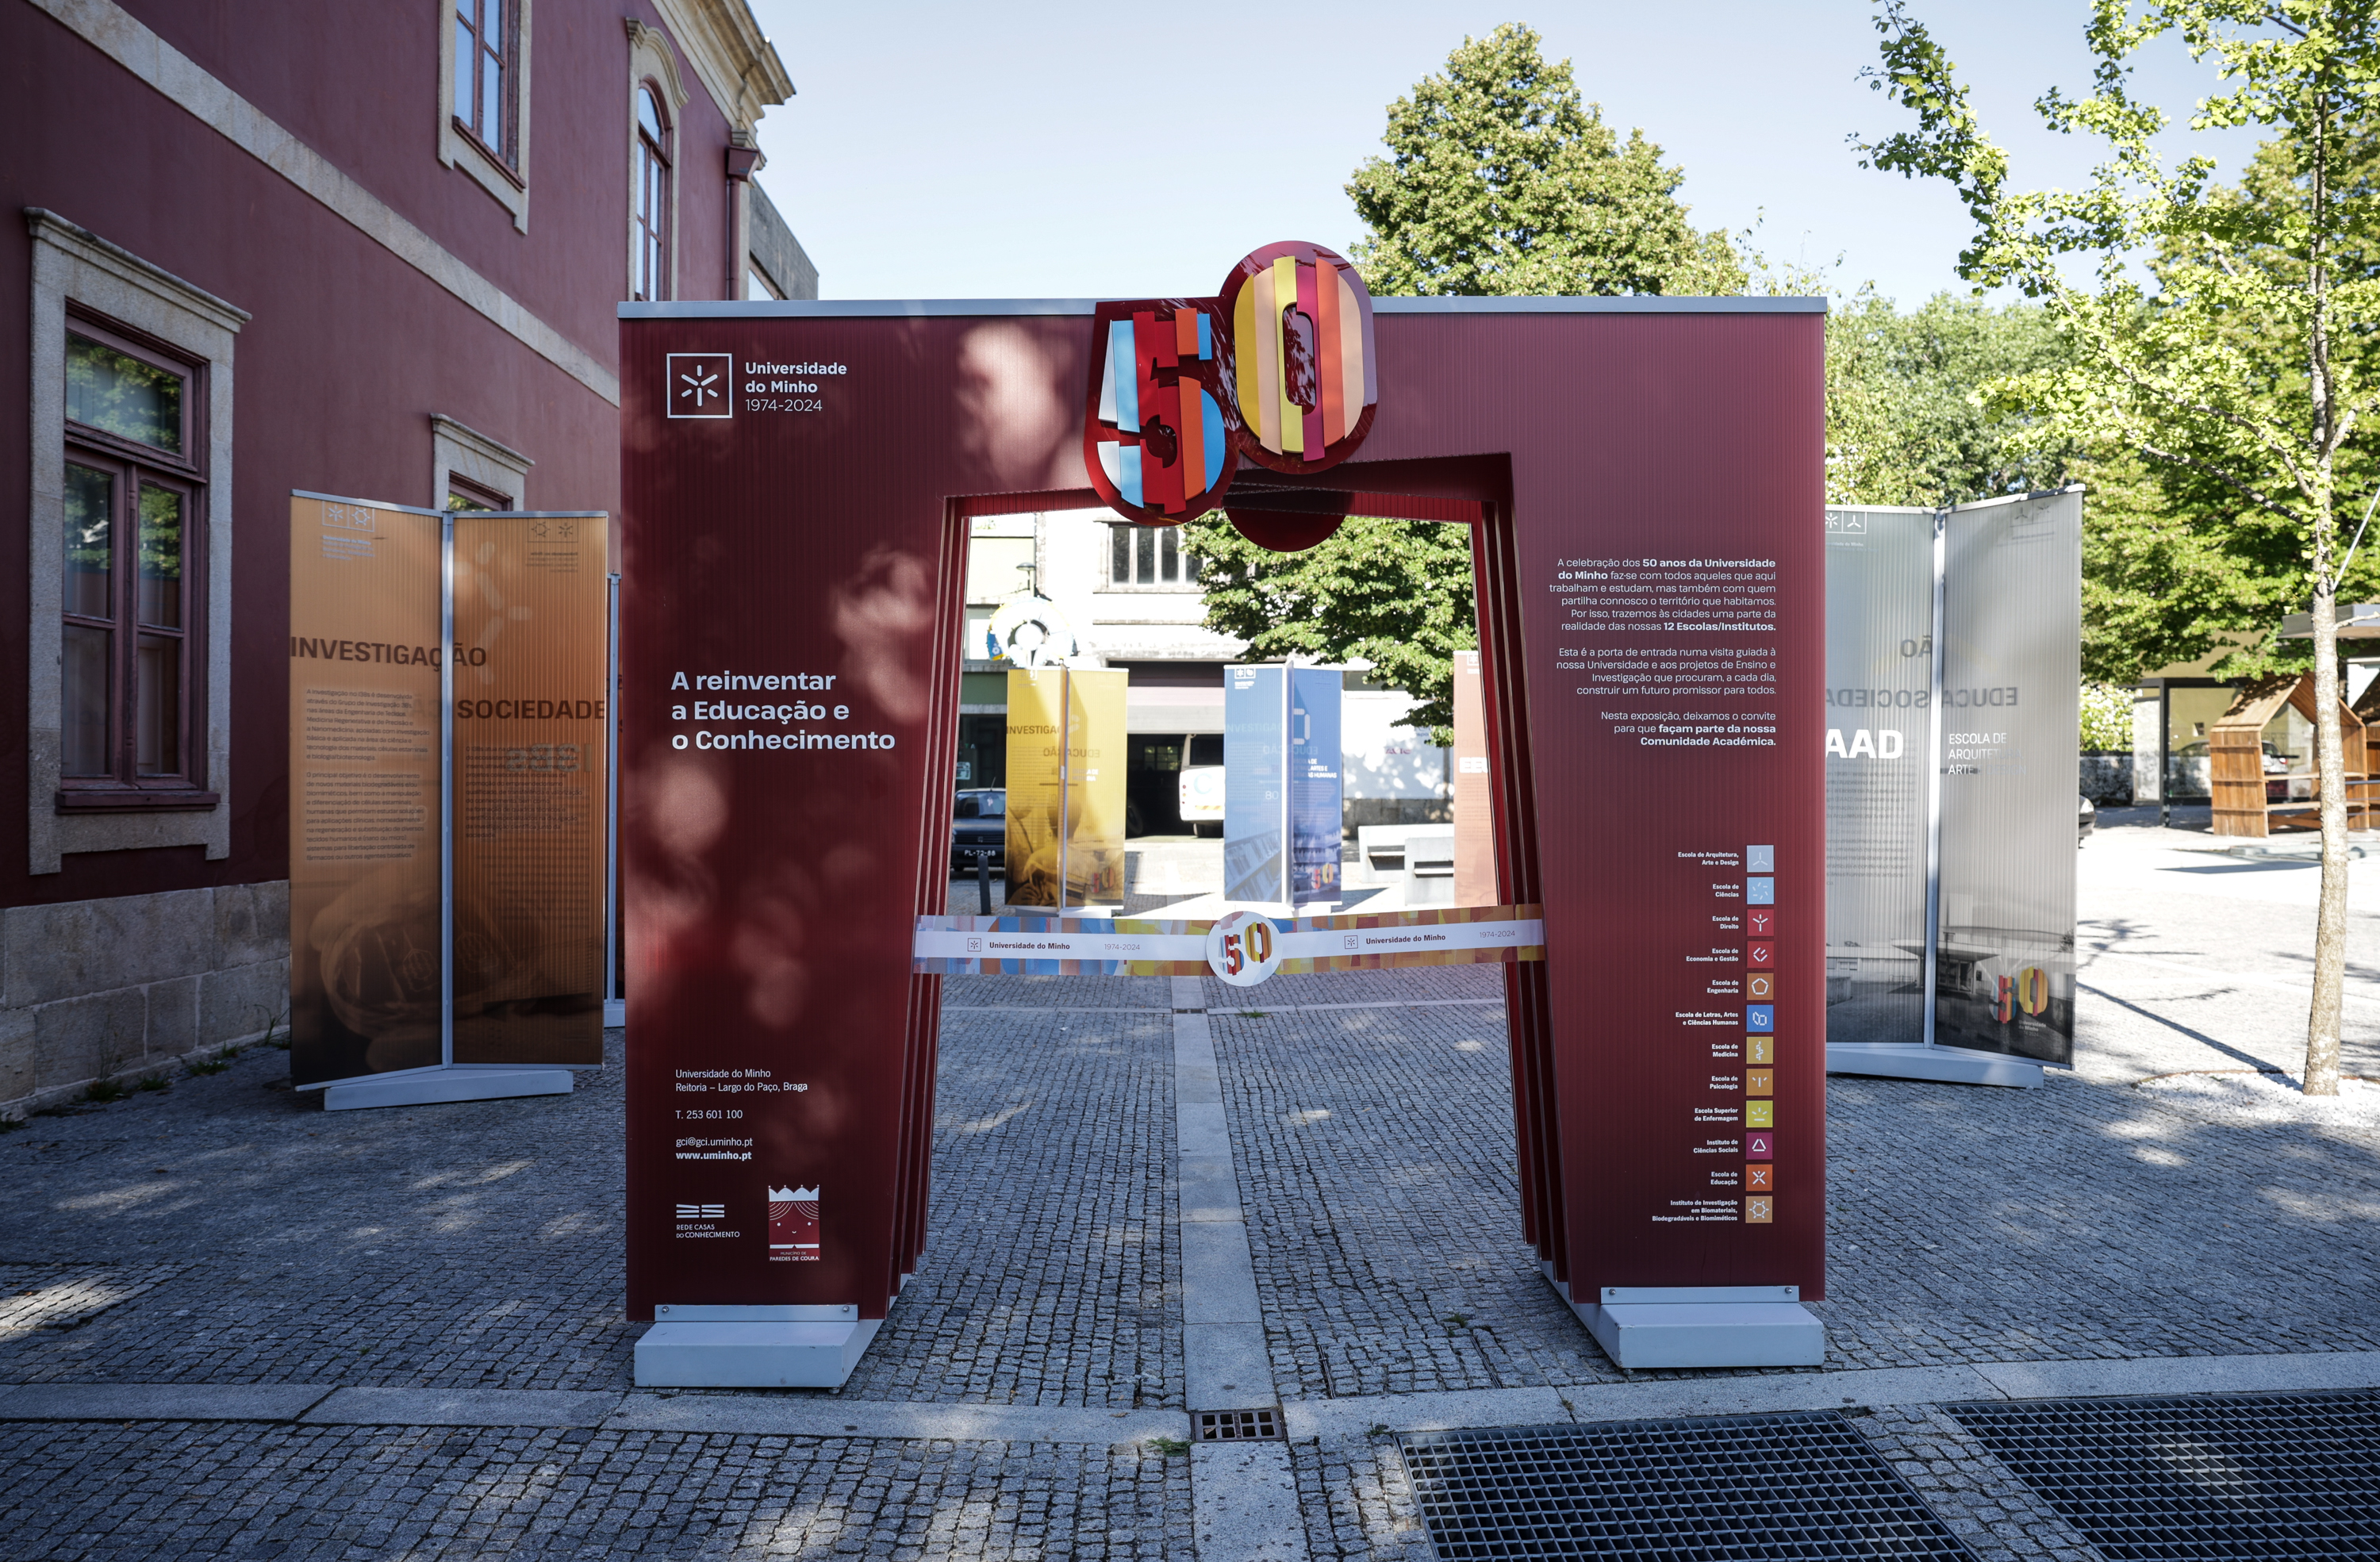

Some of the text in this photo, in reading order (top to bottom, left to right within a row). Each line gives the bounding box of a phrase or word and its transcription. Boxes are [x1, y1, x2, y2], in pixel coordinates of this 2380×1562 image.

[746, 362, 847, 374] Universidade
[746, 380, 818, 393] do Minho
[1097, 255, 1365, 515] 50
[746, 399, 823, 412] 1974-2024
[1566, 558, 1620, 569] celebração
[1622, 558, 1641, 567] dos
[1643, 558, 1657, 567] 50
[1688, 558, 1702, 567] da
[1705, 558, 1775, 567] Universidade
[1558, 570, 1572, 579] do
[1575, 570, 1608, 579] Minho
[1610, 570, 1637, 580] faz-se
[1664, 571, 1691, 580] todos
[1694, 571, 1732, 581] aqueles
[1755, 572, 1775, 581] aqui
[1549, 583, 1598, 593] trabalham
[1609, 584, 1653, 593] estudam,
[1679, 584, 1720, 593] também
[1747, 585, 1775, 594] quem
[1561, 597, 1597, 606] partilha
[1659, 596, 1700, 605] território
[1702, 598, 1722, 607] que
[1724, 597, 1776, 605] habitamos.
[1572, 609, 1587, 618] Por
[1589, 609, 1610, 618] isso,
[1659, 608, 1670, 618] às
[1672, 609, 1710, 618] cidades
[1737, 610, 1761, 620] parte
[1764, 609, 1775, 618] da
[1561, 622, 1606, 631] realidade
[1608, 622, 1626, 631] das
[1664, 622, 1675, 631] 12
[1677, 622, 1776, 631] Escolas/Institutos.
[671, 670, 836, 690] A reinventar
[457, 700, 605, 720] SOCIEDADE
[672, 700, 849, 725] a Educação e
[1601, 712, 1628, 720] Nesta
[1630, 712, 1681, 722] exposição,
[1683, 712, 1730, 720] deixamos
[1741, 712, 1775, 720] convite
[1658, 723, 1693, 735] façam
[1695, 725, 1725, 735] parte
[1727, 724, 1741, 733] da
[672, 729, 895, 750] o Conhecimento
[1641, 736, 1776, 746] Comunidade Académica.
[1949, 732, 2007, 744] ESCOLA DE
[1480, 930, 1515, 938] 1974-2024
[1219, 922, 1273, 976] 50
[676, 1069, 771, 1078] Universidade do Minho
[676, 1083, 707, 1092] Reitoria
[718, 1083, 742, 1093] Largo
[758, 1082, 780, 1092] Paço,
[783, 1082, 808, 1092] Braga
[675, 1110, 743, 1119] T. 253 601 100
[676, 1137, 753, 1148] gci@gci.uminho.pt
[676, 1150, 752, 1161] www.uminho.pt
